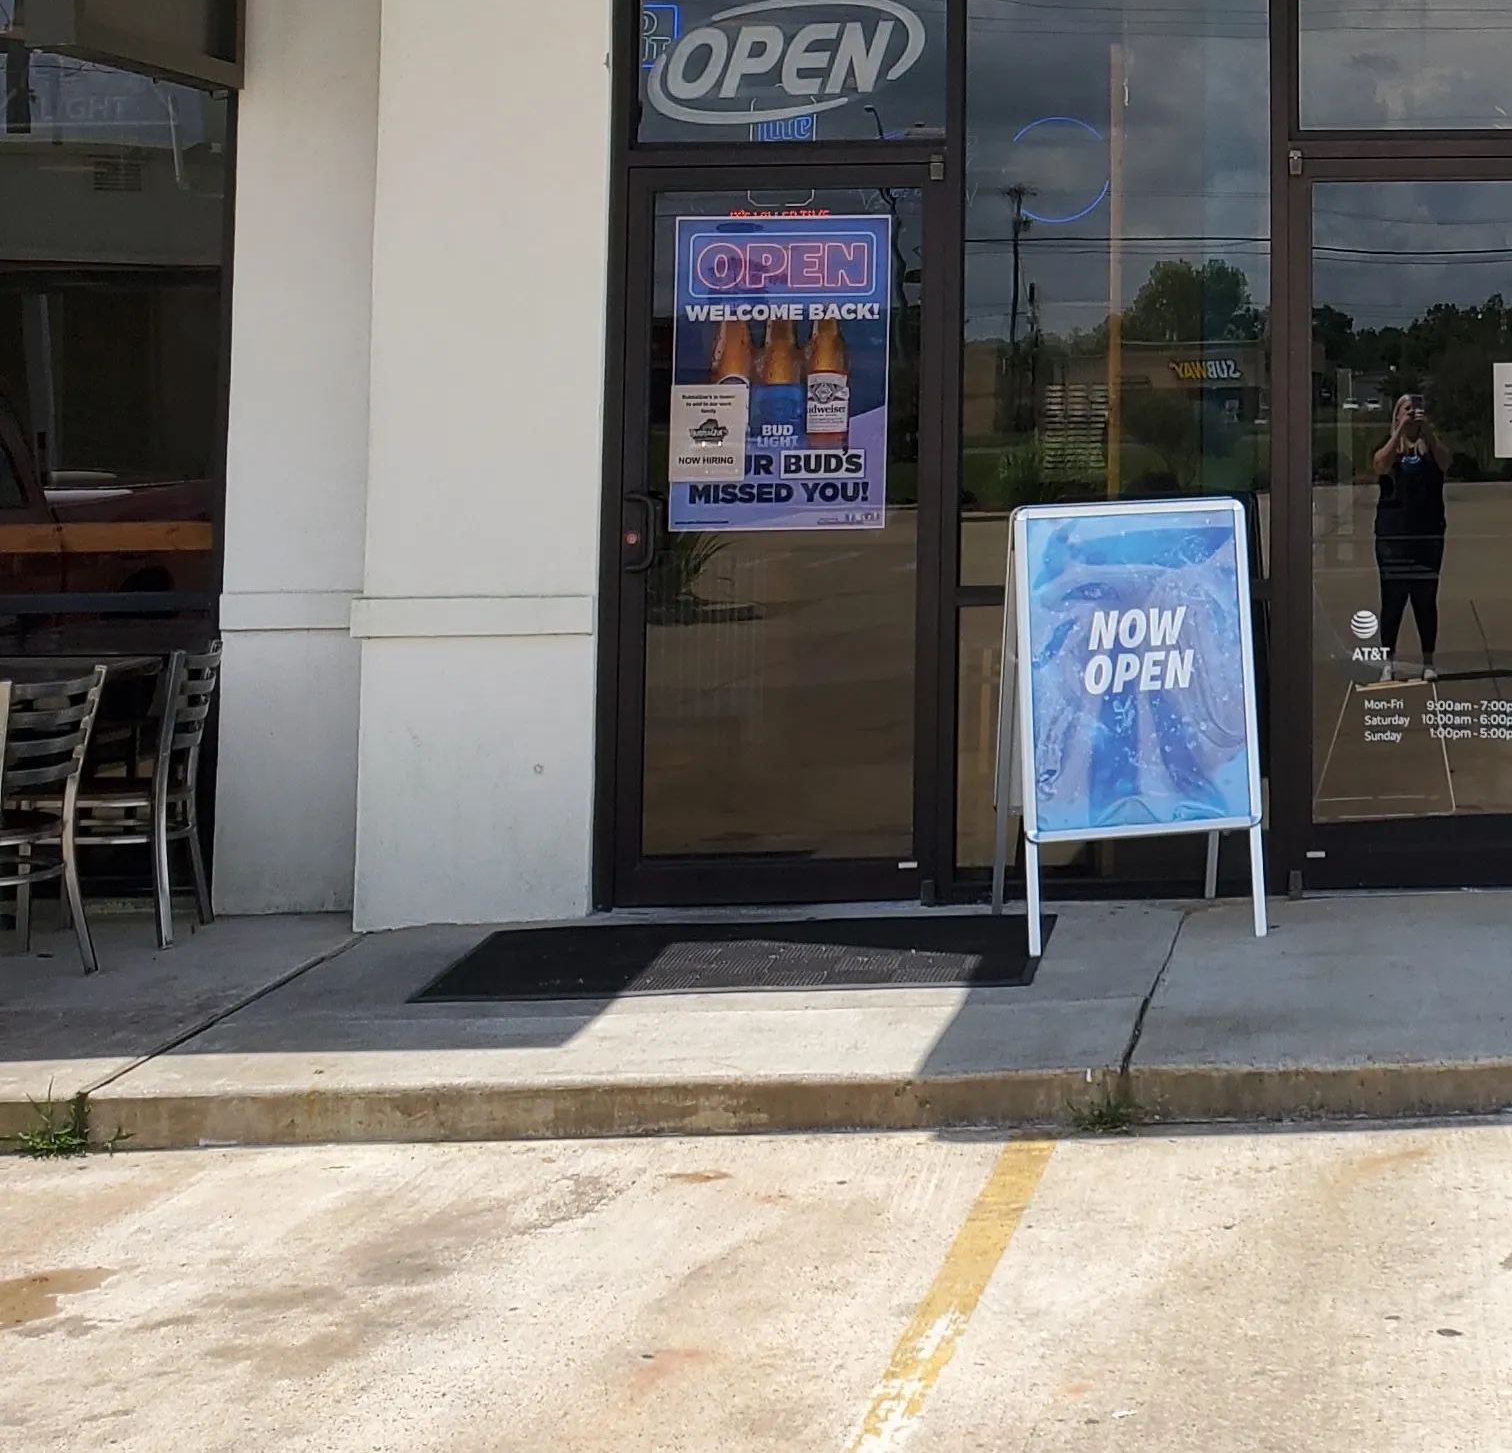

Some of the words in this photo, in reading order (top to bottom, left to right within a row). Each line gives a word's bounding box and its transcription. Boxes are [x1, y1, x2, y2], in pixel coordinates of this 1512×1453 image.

[667, 20, 896, 99] OPEN
[697, 243, 868, 289] OPEN
[685, 304, 803, 321] WELCOME
[809, 303, 880, 320] BACK!
[762, 424, 794, 436] BUD
[757, 435, 799, 448] LIGHT
[678, 456, 701, 465] NOW
[702, 456, 734, 465] HIRING
[784, 447, 863, 474] BUD'S
[688, 482, 794, 504] MISSED
[800, 481, 870, 503] YOU!
[1089, 606, 1187, 650] NOW
[1352, 647, 1390, 661] AT&T
[1084, 648, 1195, 695] OPEN
[1364, 699, 1404, 710] Mon-Fri
[1426, 700, 1472, 711] 9:00am
[1364, 715, 1410, 727] Saturday
[1421, 713, 1472, 725] 10:00am
[1364, 731, 1403, 744] Sunday
[1429, 727, 1472, 741] 1:00pm
